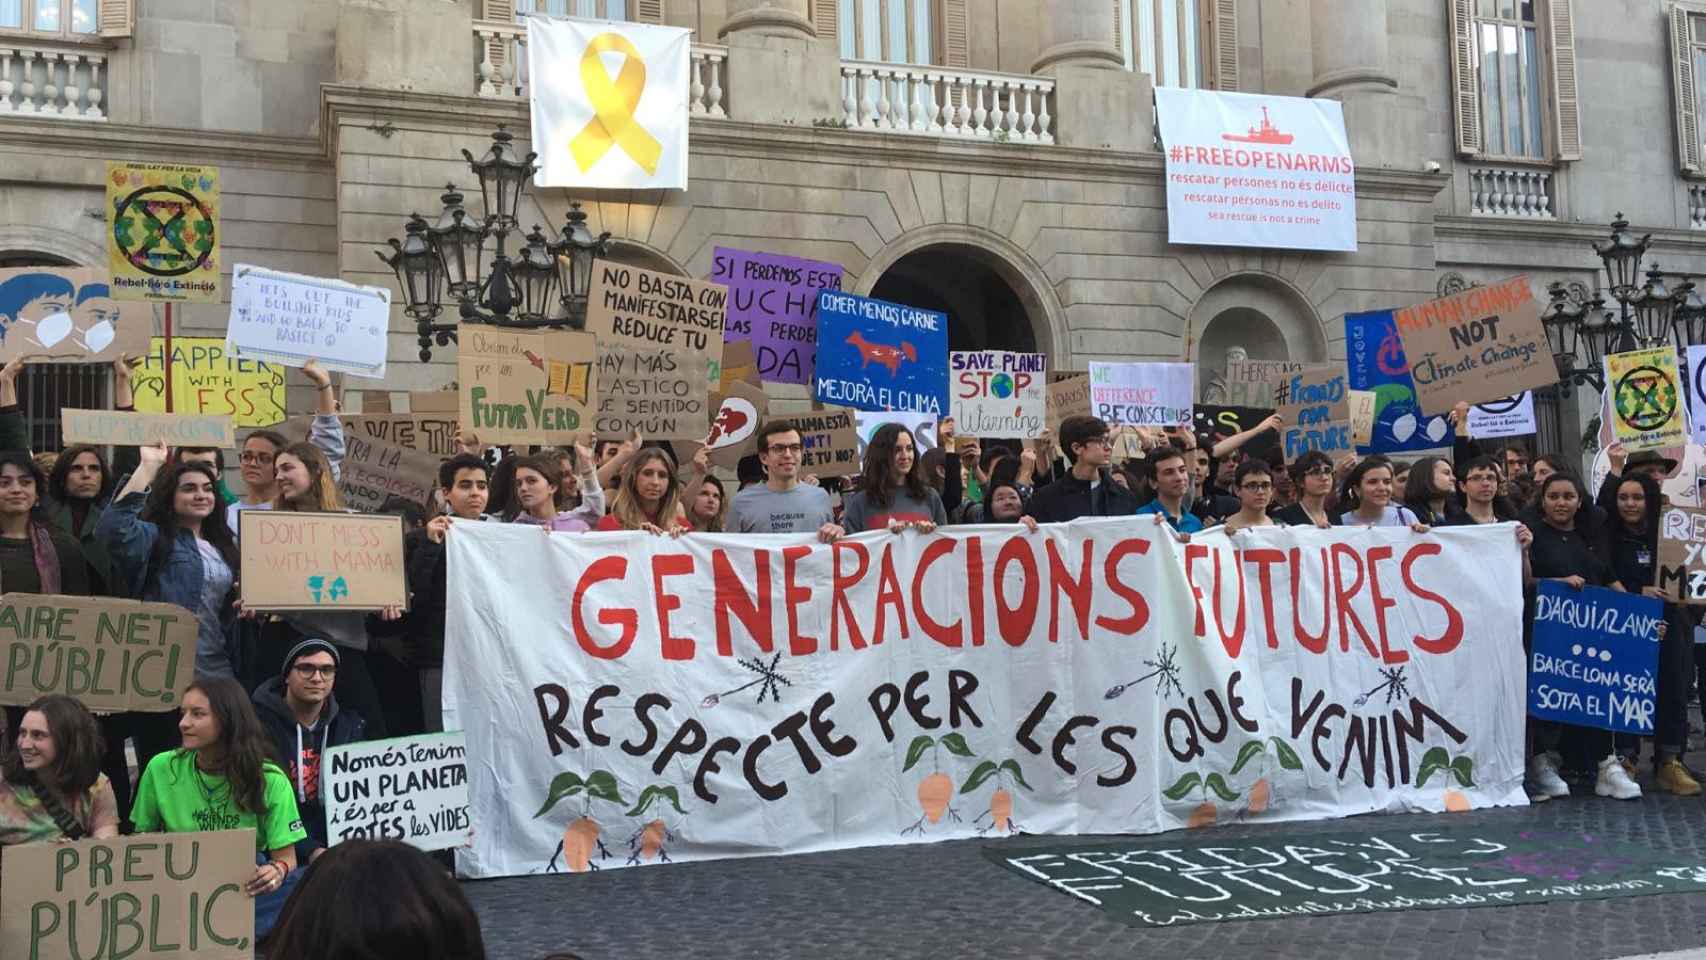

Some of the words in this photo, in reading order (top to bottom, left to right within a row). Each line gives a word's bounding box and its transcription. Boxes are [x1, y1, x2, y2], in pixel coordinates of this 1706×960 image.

[1170, 144, 1352, 175] #FREEOPENARMS
[1170, 173, 1220, 186] rescatar
[1224, 175, 1278, 190] persones
[1281, 179, 1296, 191] no
[1314, 178, 1353, 194] delicte
[1184, 192, 1231, 206] rescatar
[1231, 195, 1280, 210] personas
[1282, 198, 1296, 209] no
[1311, 198, 1342, 211] delito
[1226, 213, 1258, 222] rescue
[1269, 214, 1287, 224] not
[1295, 215, 1321, 225] crime
[602, 266, 631, 289] NO
[638, 272, 695, 304] BASTA
[699, 288, 728, 309] CON
[713, 256, 734, 279] SI
[744, 260, 803, 287] PERDEMOS
[807, 269, 843, 292] ESTA
[821, 292, 858, 316] COMER
[900, 307, 940, 332] CARNE
[1394, 297, 1464, 332] HUMAN
[612, 315, 678, 345] REDUCE
[682, 328, 708, 351] TU
[1449, 315, 1501, 350] NOT
[634, 350, 678, 375] MÁS
[951, 353, 995, 371] SAVE
[1002, 353, 1048, 373] PLANET
[1412, 352, 1479, 386] Climate
[1481, 341, 1538, 367] Change
[188, 375, 233, 387] WITH
[596, 376, 690, 398] LASTICO
[625, 399, 701, 414] SENTIDO
[879, 388, 897, 411] EL
[897, 390, 941, 416] CLIMA
[954, 400, 1042, 438] Warning
[1098, 403, 1125, 423] BE
[595, 415, 677, 433] COMÚN
[257, 518, 321, 546] DON'T
[331, 524, 381, 548] MESS
[332, 550, 396, 571] MAMA
[571, 535, 1151, 661] GENERACIONS
[1183, 541, 1466, 665] FUTURES
[0, 604, 80, 642] AIRE
[94, 610, 178, 647] NET
[5, 641, 182, 704] PÚBLIC!
[1532, 653, 1621, 687] BARCELONA
[1536, 684, 1583, 710] SOTA
[1586, 696, 1607, 717] EL
[1607, 691, 1655, 730] MAR
[533, 682, 858, 804] RESPECTE
[867, 669, 985, 744] PER
[1015, 690, 1137, 788] LES
[1163, 670, 1260, 764] QUE
[1290, 676, 1469, 789] VENIM
[331, 746, 407, 775] Només
[333, 777, 370, 803] UN
[378, 763, 468, 798] PLANETA
[55, 840, 200, 892] PREU
[29, 882, 249, 960] PÚBLIC,
